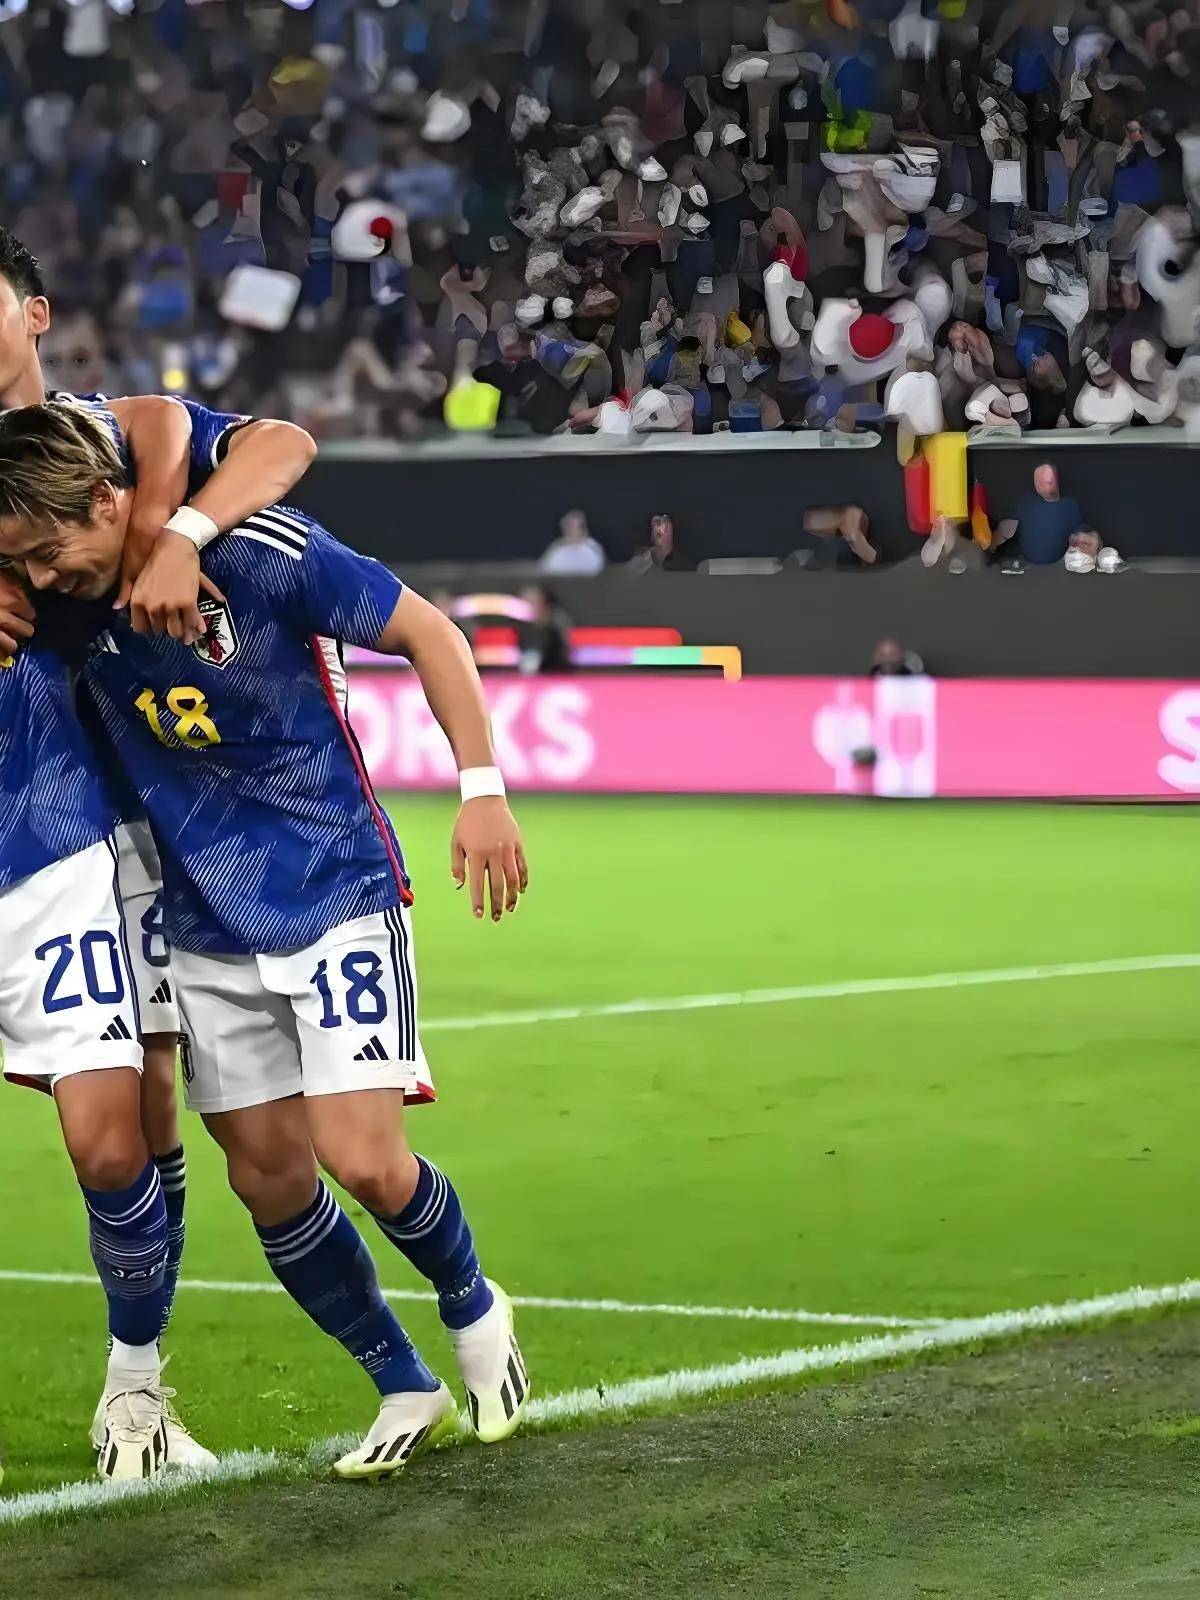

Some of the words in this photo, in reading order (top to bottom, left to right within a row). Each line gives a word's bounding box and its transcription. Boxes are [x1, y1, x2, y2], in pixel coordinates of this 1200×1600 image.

[134, 686, 221, 749] 18
[35, 930, 125, 1014] 20
[310, 951, 388, 1028] 18
